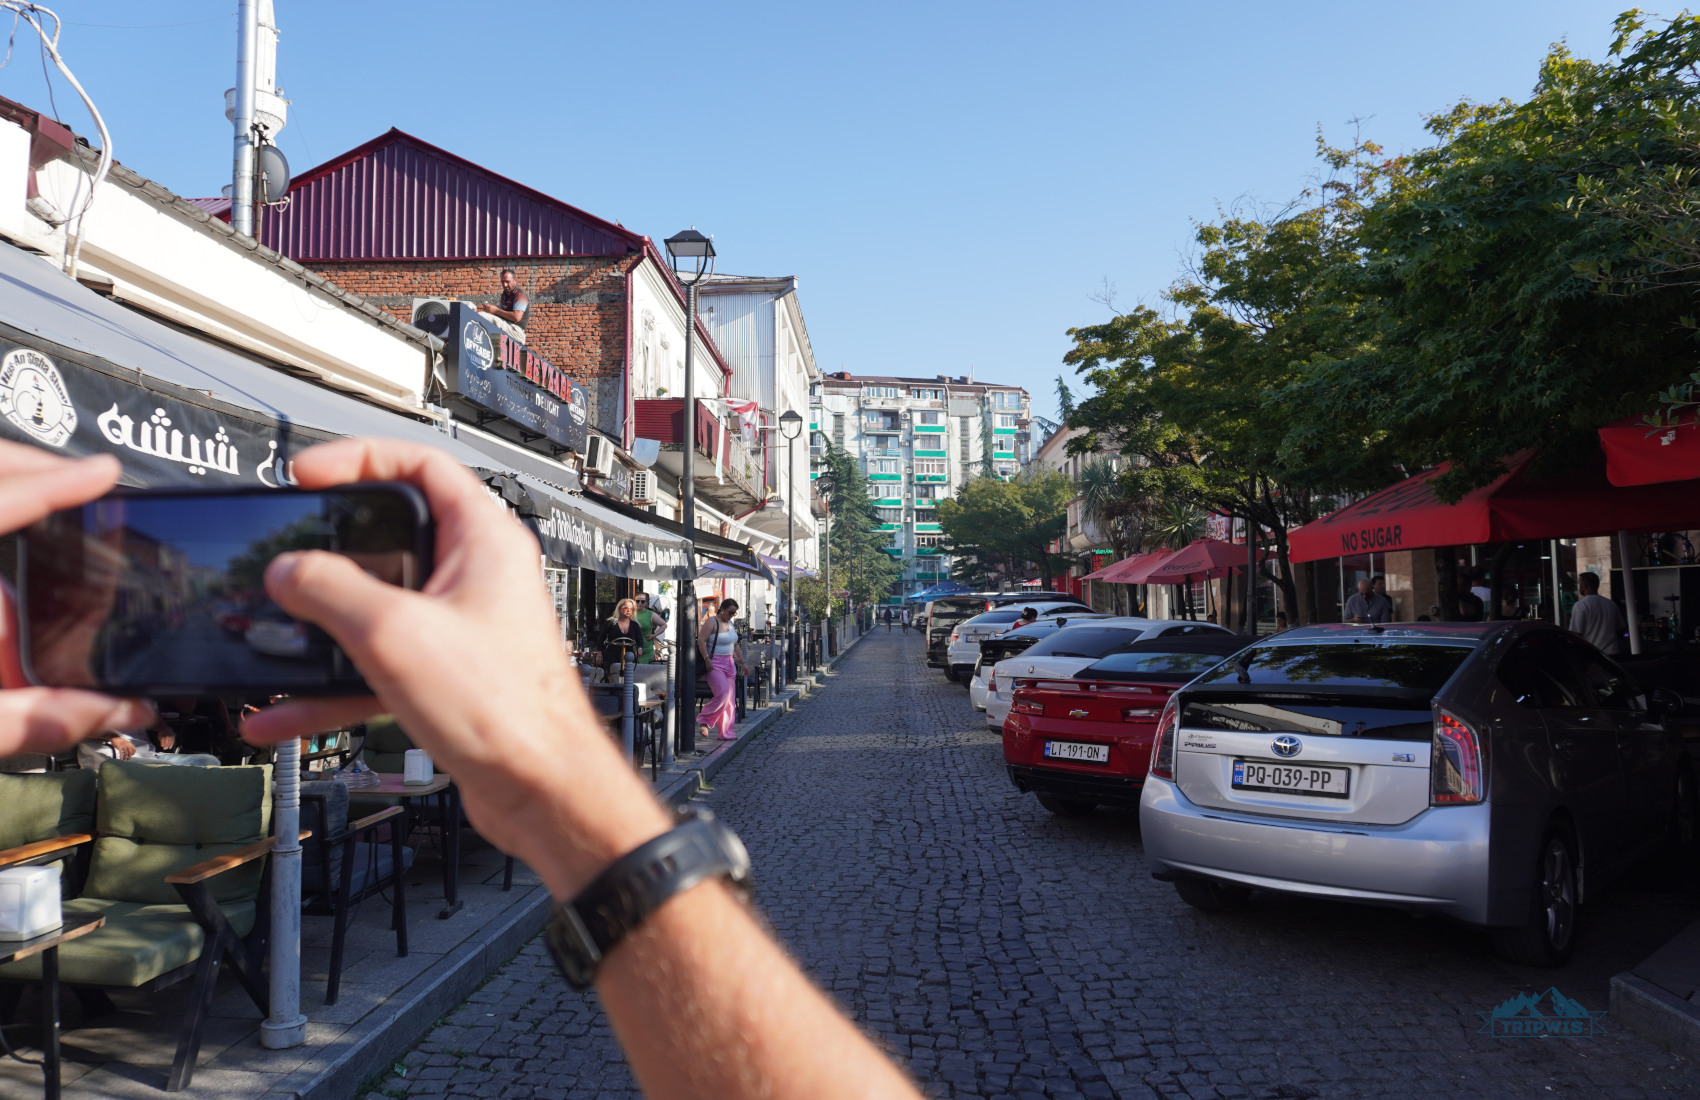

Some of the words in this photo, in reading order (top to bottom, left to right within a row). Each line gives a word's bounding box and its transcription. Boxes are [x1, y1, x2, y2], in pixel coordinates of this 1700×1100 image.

[525, 351, 573, 405] BEYZADE
[535, 392, 560, 418] DELIGHT
[1341, 532, 1358, 552] NO
[1360, 524, 1402, 549] SUGAR
[1050, 743, 1100, 760] LI-191-ON
[1246, 765, 1332, 790] PQ-039-PP
